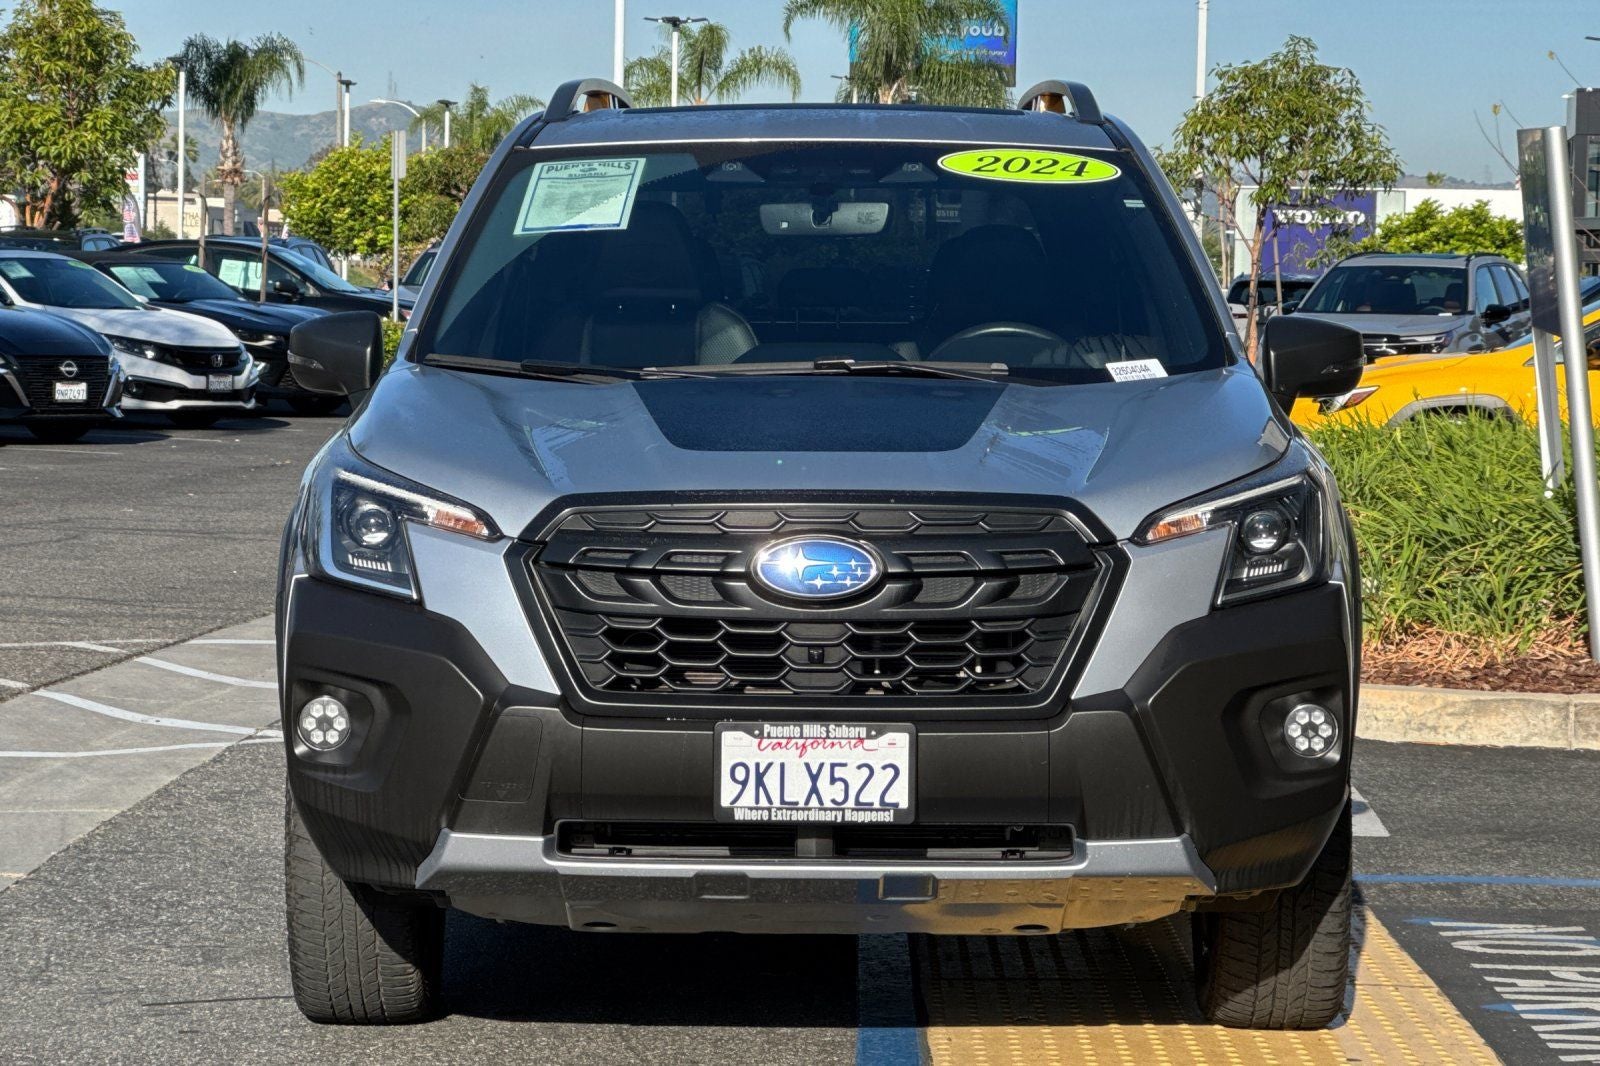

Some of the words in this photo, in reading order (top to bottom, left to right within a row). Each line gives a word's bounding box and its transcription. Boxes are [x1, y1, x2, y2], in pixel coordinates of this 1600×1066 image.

[546, 162, 594, 174] PUENTE
[599, 161, 632, 170] HILLS
[972, 155, 1090, 177] 2024
[763, 724, 802, 738] Puente
[803, 724, 827, 738] Hills
[828, 724, 867, 739] Subaru
[757, 738, 878, 759] California
[729, 761, 900, 808] 9KLX522
[734, 807, 769, 821] Where
[771, 808, 842, 822] Extraordinary
[844, 808, 894, 823] Happens!
